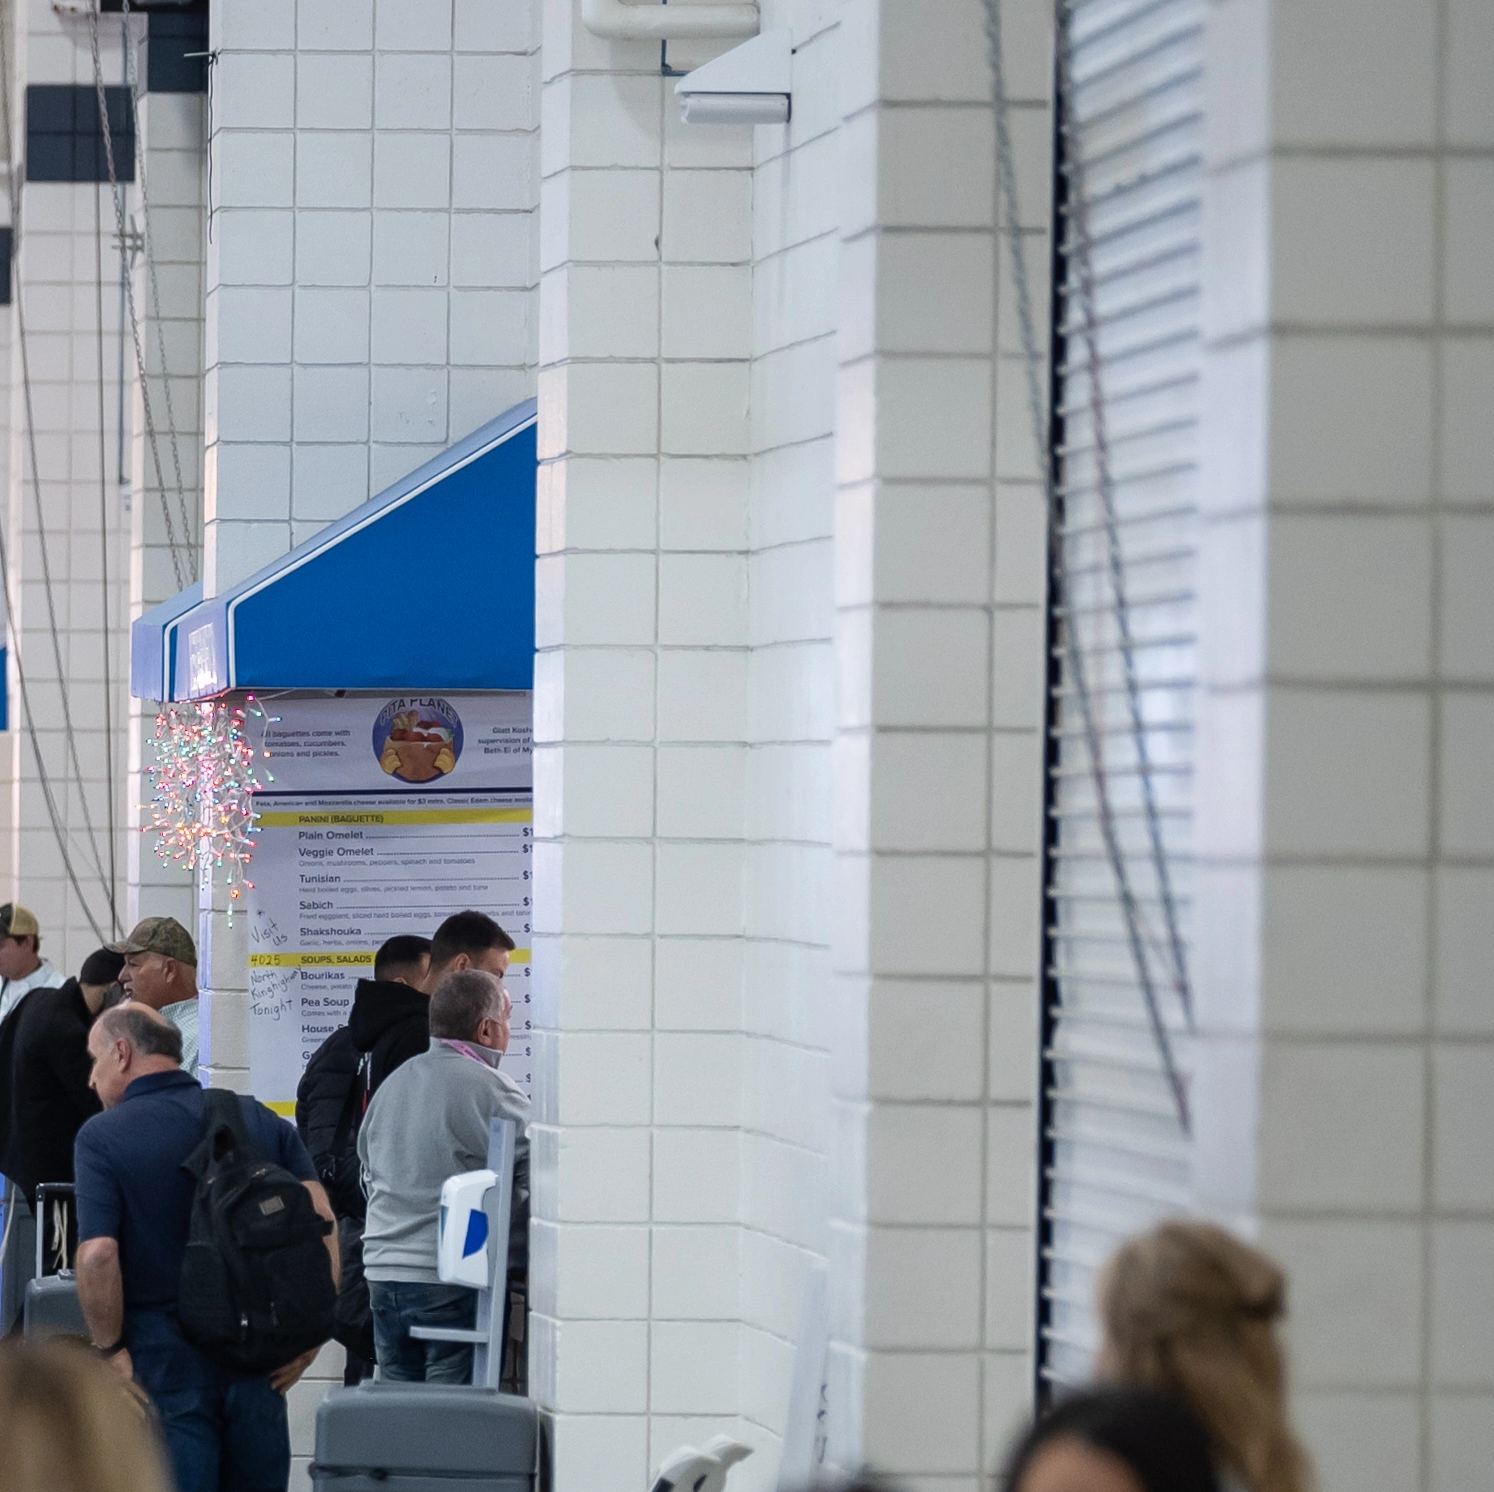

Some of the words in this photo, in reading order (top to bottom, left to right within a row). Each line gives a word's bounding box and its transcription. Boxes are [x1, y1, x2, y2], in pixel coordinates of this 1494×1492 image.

[380, 699, 406, 726] PITA
[272, 730, 310, 739] baguettes
[299, 815, 329, 823] PANINI
[331, 814, 384, 824] (BAGUETTE)
[298, 831, 323, 840] Plain
[326, 830, 363, 840] Omelet
[298, 847, 333, 858] Veggie
[337, 847, 374, 856] Omelet
[401, 858, 427, 866] spinach
[299, 874, 341, 883] Tunisian
[384, 885, 409, 893] pickled
[299, 901, 333, 910] Sabich
[300, 927, 361, 936] Shakshouka
[251, 955, 281, 966] 4025
[337, 955, 372, 964] SALADS
[301, 971, 345, 980] Bourikas
[301, 997, 320, 1007] Pea
[323, 997, 350, 1008] Soup
[250, 999, 293, 1021] Tonight
[302, 1024, 334, 1033] House
